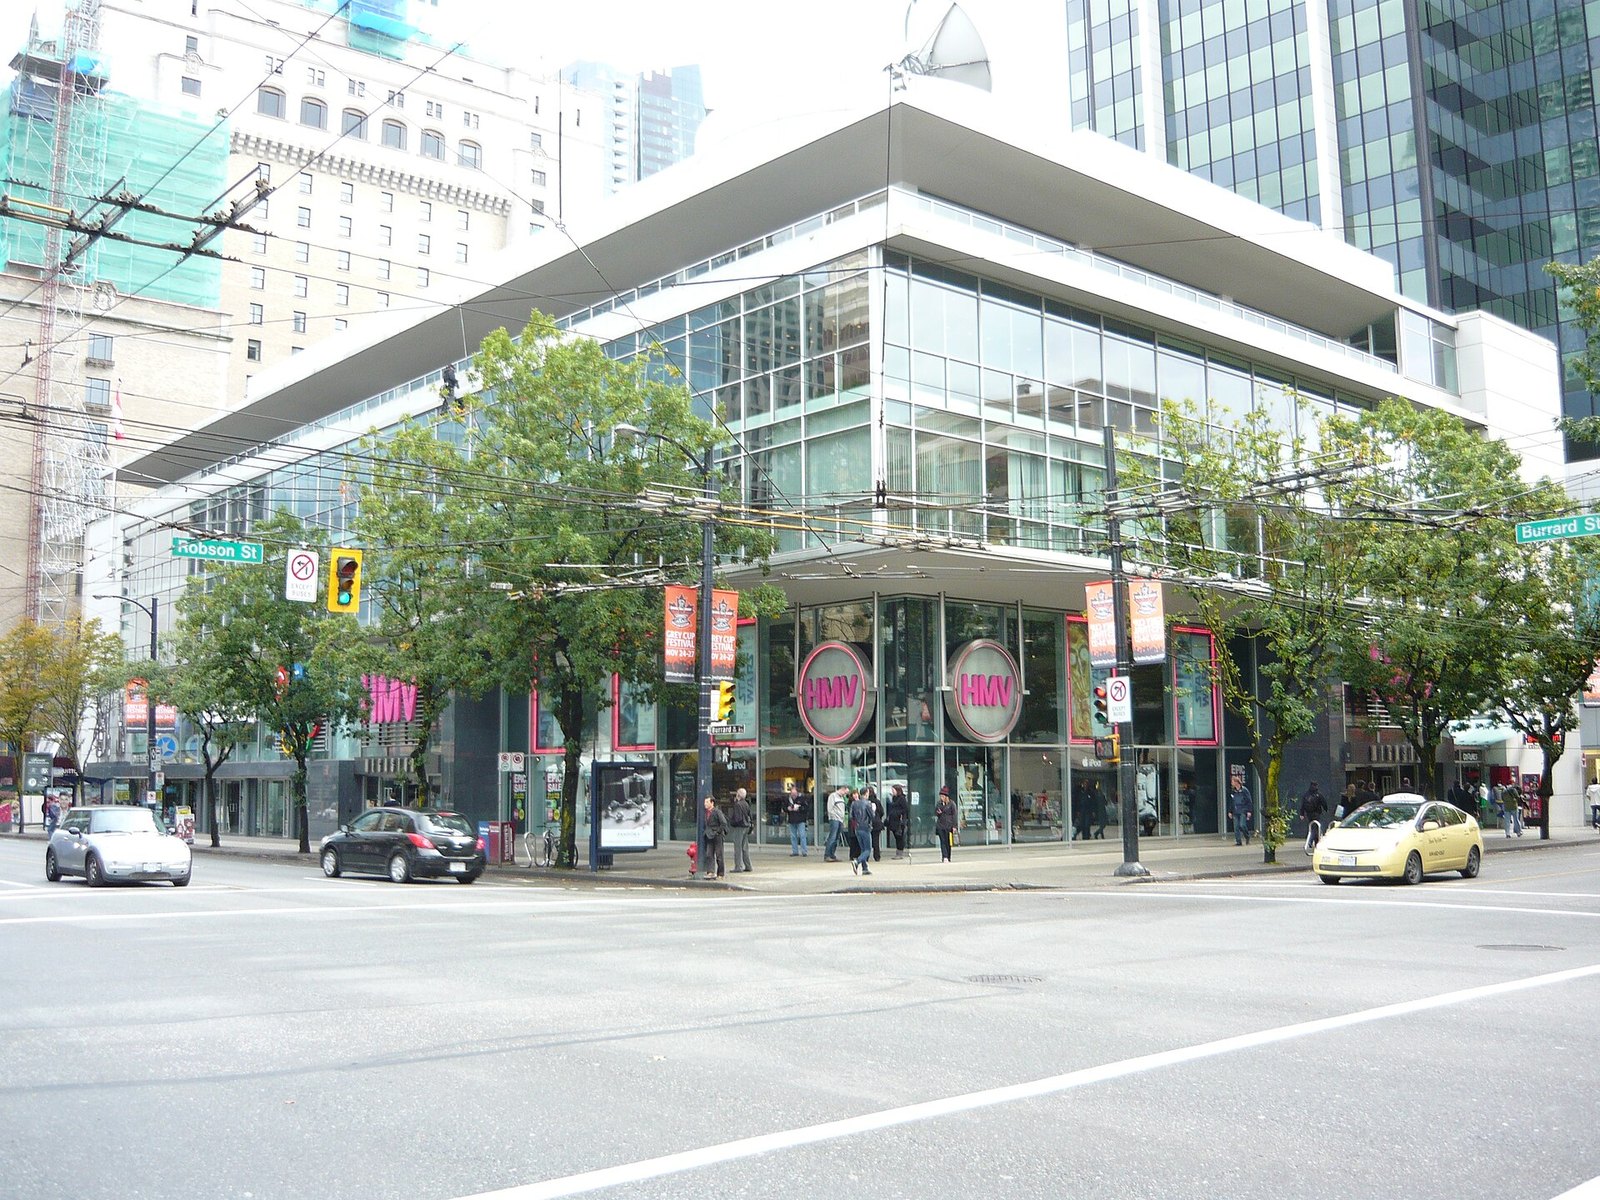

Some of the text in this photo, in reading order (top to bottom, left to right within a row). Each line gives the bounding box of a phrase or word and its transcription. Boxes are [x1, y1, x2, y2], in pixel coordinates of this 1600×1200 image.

[1521, 516, 1600, 539] Burrard St
[178, 539, 257, 559] Robson St
[666, 630, 695, 640] GREY CUP
[711, 633, 736, 643] REY CUP
[666, 638, 695, 648] FESTIVAL
[711, 642, 735, 652] ESTIVAL
[666, 648, 695, 658] NOV 24-27
[711, 652, 720, 660] OV
[805, 674, 858, 710] HMV
[961, 673, 1012, 707] HMV
[733, 760, 746, 770] iPod
[1230, 764, 1246, 775] EPIC
[513, 773, 527, 783] EPIC
[547, 772, 563, 783] EPIC
[513, 783, 527, 793] SALE
[547, 783, 562, 792] SALE
